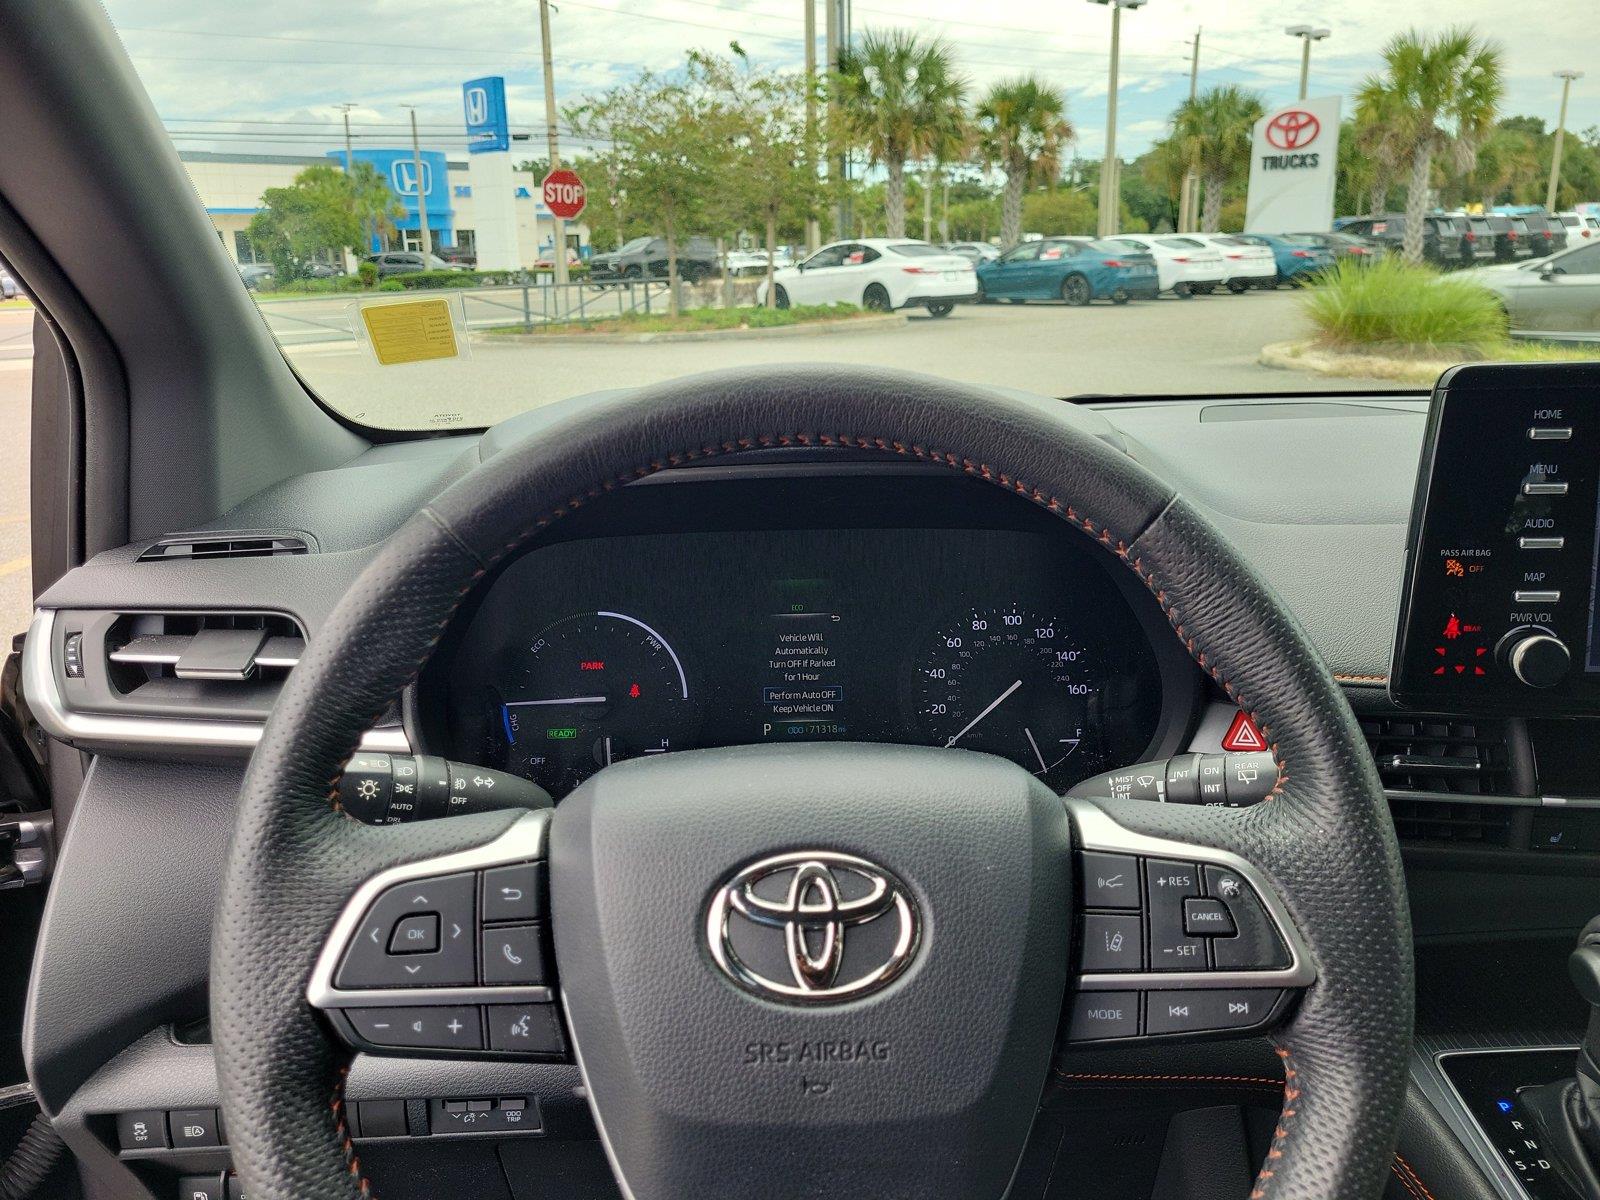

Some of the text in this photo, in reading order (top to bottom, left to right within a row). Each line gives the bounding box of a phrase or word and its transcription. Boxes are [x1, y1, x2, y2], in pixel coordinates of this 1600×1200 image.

[1262, 153, 1319, 170] TRUCKS
[545, 183, 583, 204] STOP
[1533, 408, 1562, 420] HOME
[1529, 463, 1558, 475] MENU
[1524, 518, 1555, 529] AUDIO
[1440, 549, 1492, 557] PASS AIR BAG
[1468, 565, 1485, 573] OFF
[1524, 571, 1546, 582] MAP
[1002, 615, 1023, 626] 100
[1510, 611, 1553, 623] PWR VOL
[972, 620, 987, 631] 80
[779, 633, 824, 642] Vehicle Will
[1006, 633, 1018, 641] 160
[1034, 628, 1054, 639] 120
[530, 638, 546, 653] ECO
[645, 635, 661, 651] PWR
[946, 637, 962, 648] 60
[775, 646, 829, 656] Automatically
[958, 650, 971, 658] 100
[1055, 650, 1077, 662] 140
[580, 661, 605, 671] PARK
[769, 659, 836, 668] Turn OFF If Parked
[784, 673, 821, 681] for 1 Hour
[929, 668, 946, 679] 40
[947, 678, 957, 686] 60
[1066, 684, 1088, 695] 160
[769, 690, 836, 702] Perform Auto OFF
[773, 703, 834, 715] Keep Vehicle ON
[931, 704, 947, 715] 20
[510, 713, 520, 732] CHG
[763, 723, 772, 736] P
[809, 725, 838, 734] 71318
[1076, 729, 1082, 737] F
[661, 738, 670, 748] H
[948, 735, 956, 746] 0
[530, 757, 546, 766] OFF
[1234, 762, 1259, 770] REAR
[1173, 770, 1190, 779] INT
[1204, 767, 1219, 775] ON
[1204, 784, 1221, 793] INT
[451, 796, 468, 804] OFF
[390, 803, 413, 811] AUTO
[1191, 912, 1223, 921] CANCEL
[408, 930, 424, 940] OK
[1088, 1009, 1122, 1020] MODE
[745, 1040, 890, 1063] SRS AIRBAG
[1498, 1102, 1509, 1111] P
[1511, 1121, 1524, 1130] R
[1524, 1140, 1538, 1149] N
